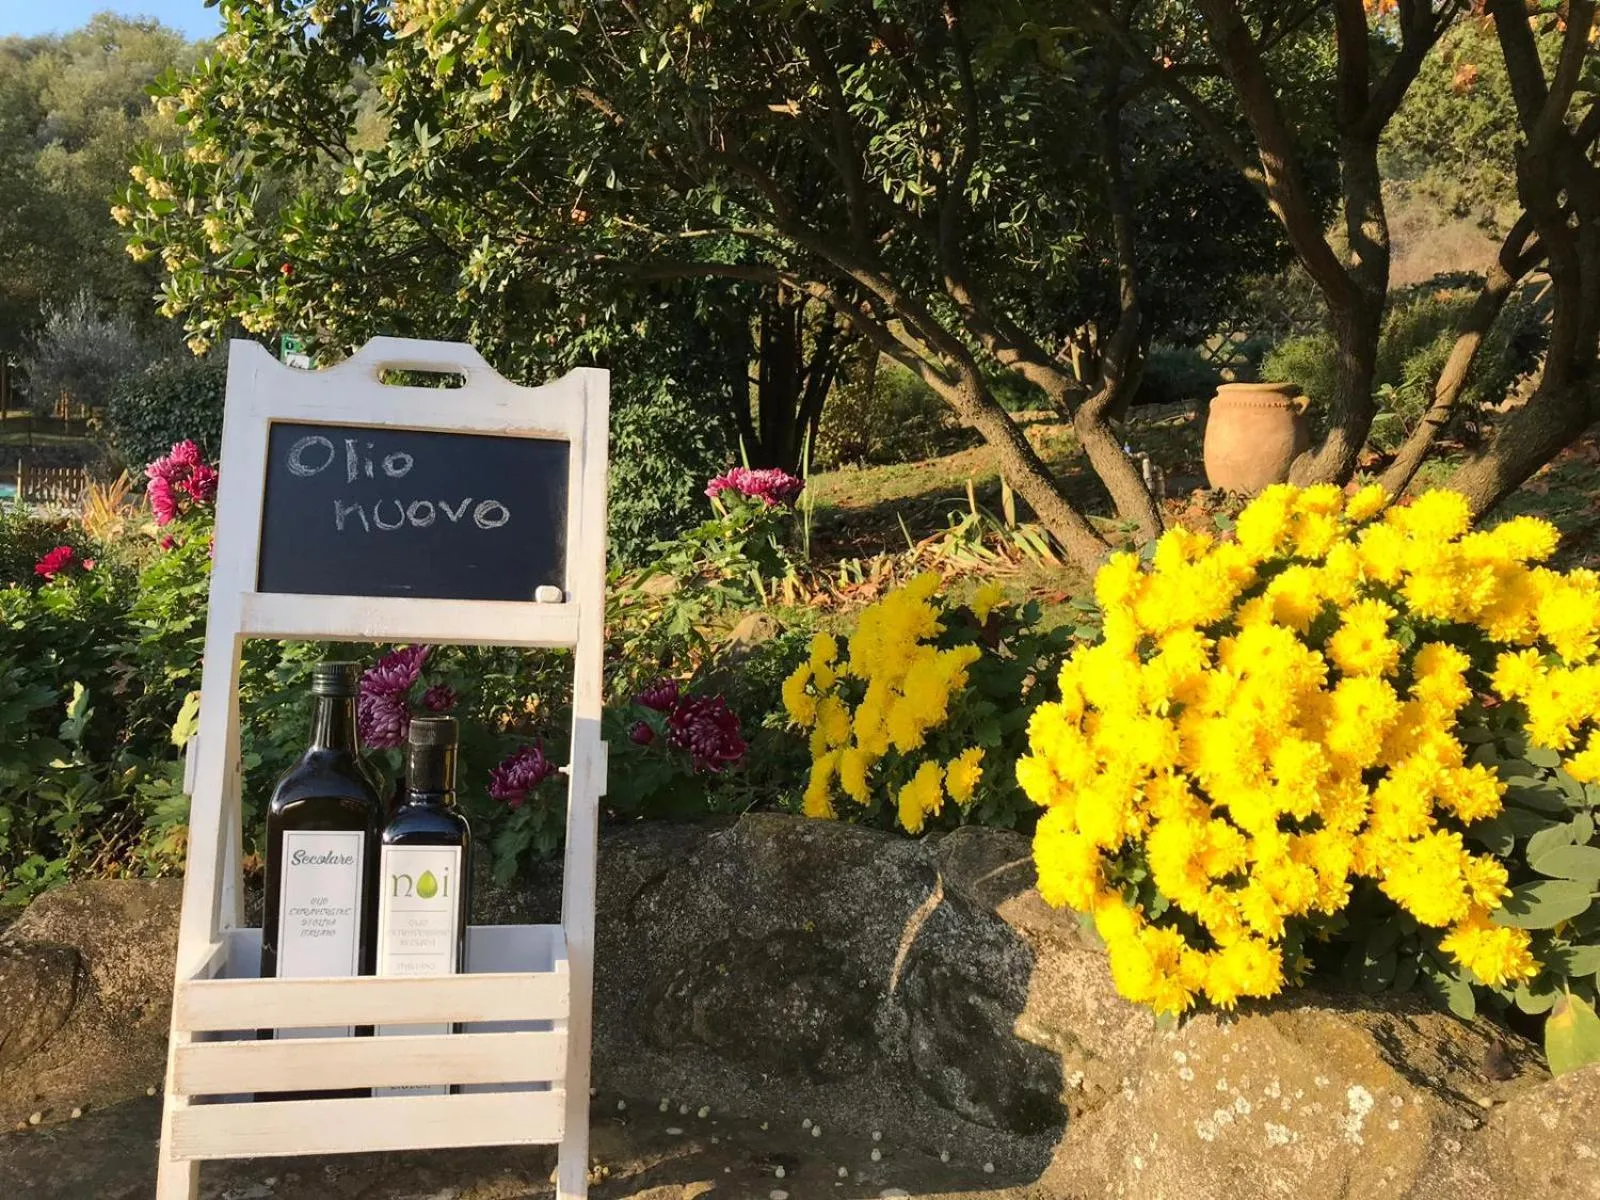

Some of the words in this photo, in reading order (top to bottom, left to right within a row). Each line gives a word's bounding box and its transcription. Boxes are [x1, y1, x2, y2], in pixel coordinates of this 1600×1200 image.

[287, 435, 414, 483] Olio
[333, 498, 511, 533] nuovo
[291, 849, 355, 866] Secolare
